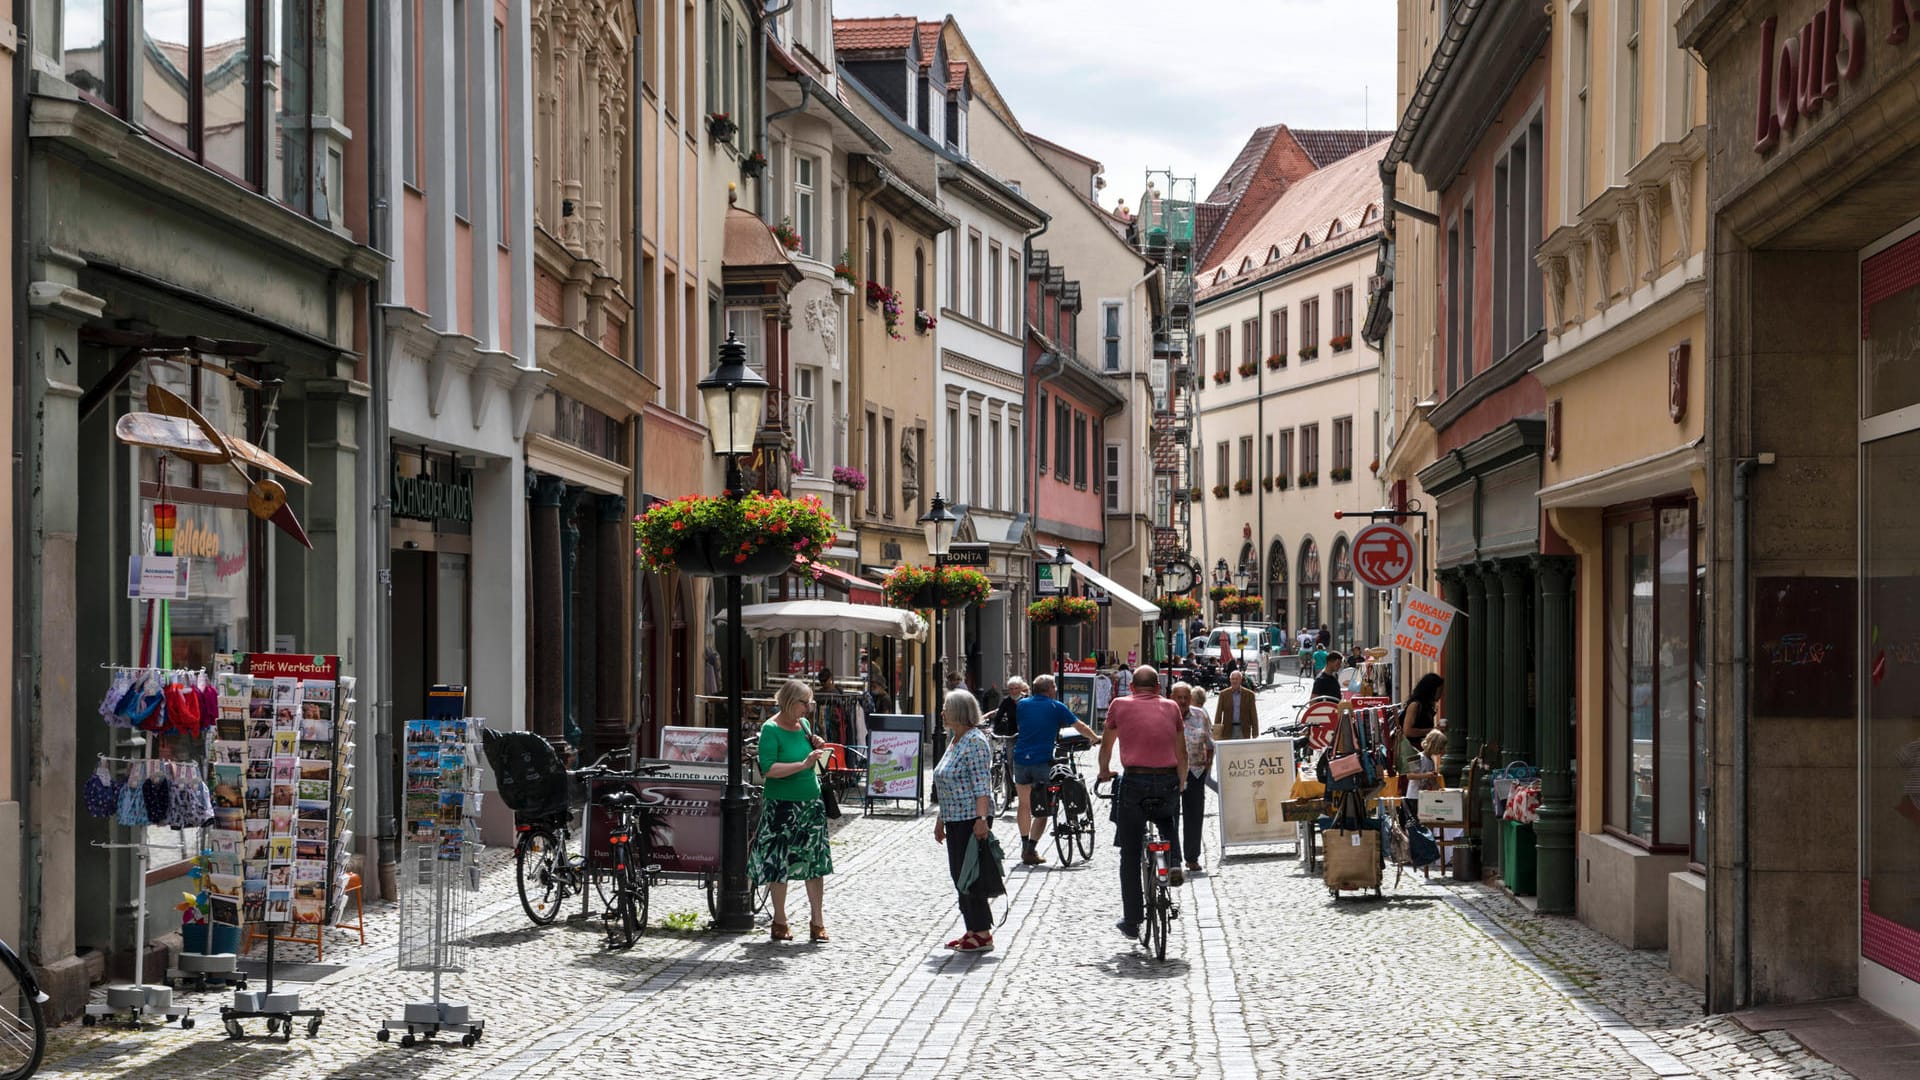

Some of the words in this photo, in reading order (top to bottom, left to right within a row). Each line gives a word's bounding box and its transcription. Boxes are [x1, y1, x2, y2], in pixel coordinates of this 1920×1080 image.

[1408, 598, 1452, 623] ANKAUF
[1407, 614, 1443, 636] GOLD
[1415, 631, 1425, 640] u.
[1394, 633, 1438, 660] SILBER
[278, 661, 332, 673] Werkstatt
[1063, 663, 1080, 672] 50%
[1228, 760, 1255, 770] AUS
[1259, 756, 1284, 768] ALT
[1229, 769, 1256, 777] MACH
[1258, 767, 1285, 776] GOLD
[638, 786, 714, 807] Sturm
[652, 852, 676, 861] Kinder
